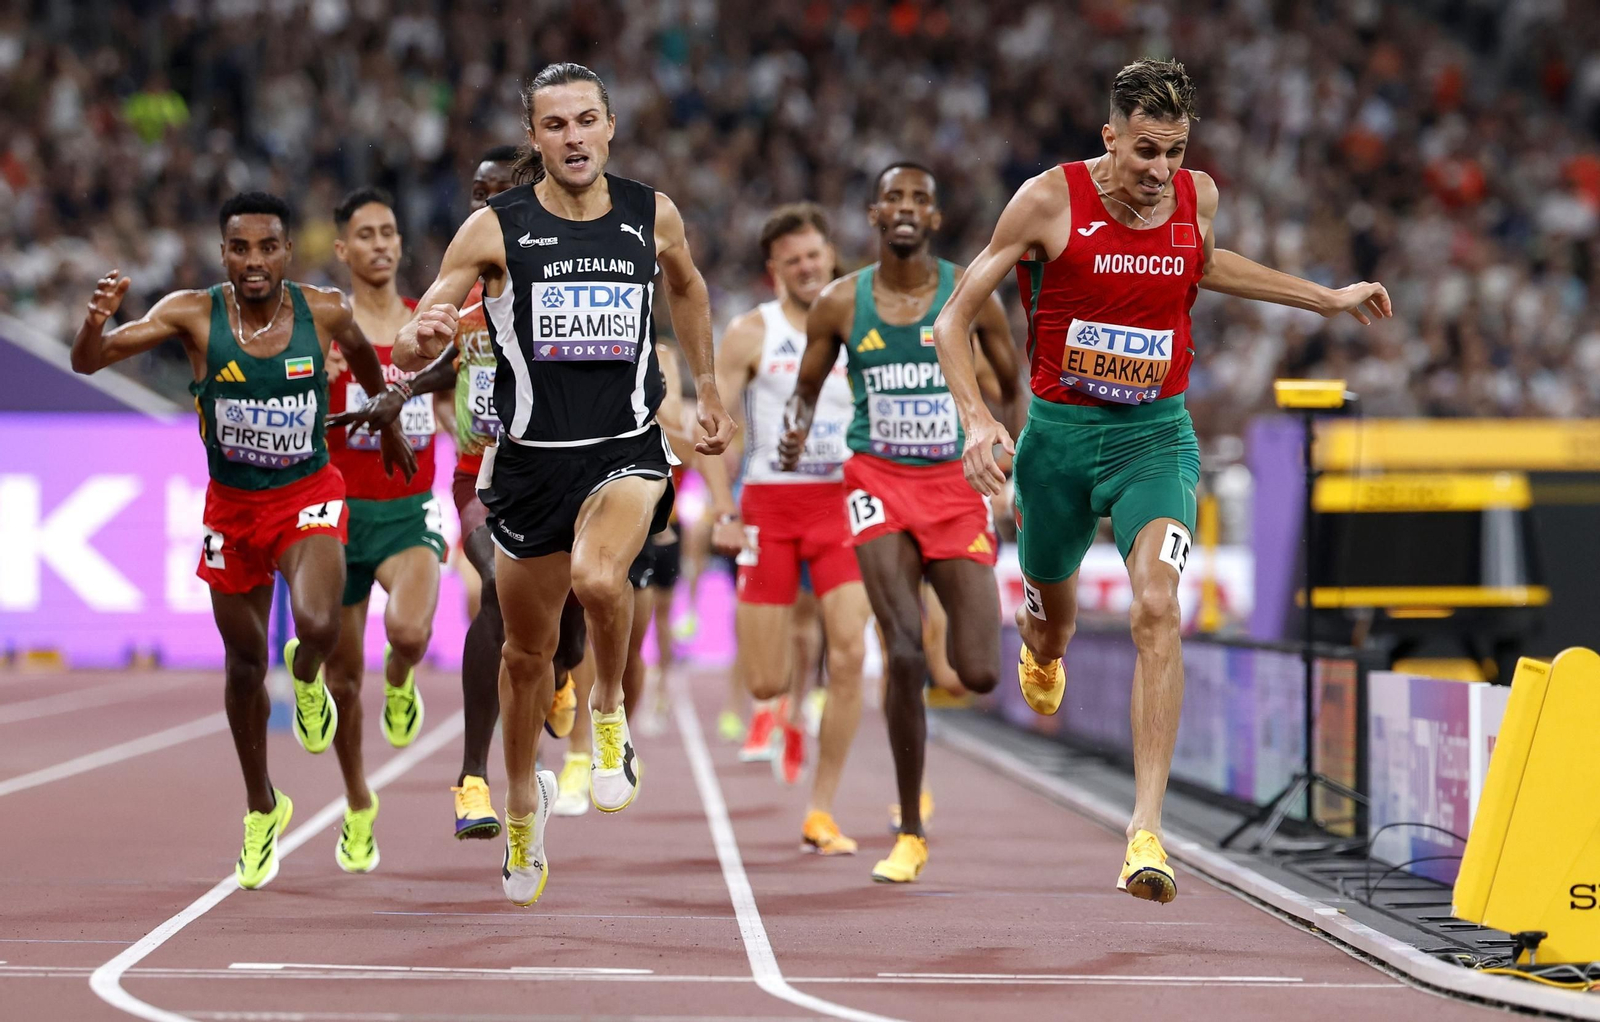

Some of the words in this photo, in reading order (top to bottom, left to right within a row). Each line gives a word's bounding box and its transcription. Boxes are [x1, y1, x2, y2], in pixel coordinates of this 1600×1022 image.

[543, 259, 573, 279] NEW
[576, 257, 635, 276] ZEALAND
[1093, 254, 1185, 276] MOROCCO
[564, 285, 636, 309] TDK
[539, 314, 636, 338] BEAMISH
[1101, 327, 1169, 357] TDK
[1067, 349, 1088, 374] EL
[1093, 354, 1168, 385] BAKKALI
[245, 407, 308, 428] TDK
[894, 398, 950, 416] TDK
[221, 425, 307, 452] FIREWU
[876, 420, 952, 439] GIRMA
[852, 496, 876, 523] 13
[1171, 532, 1190, 574] 15
[1570, 884, 1600, 911] S
